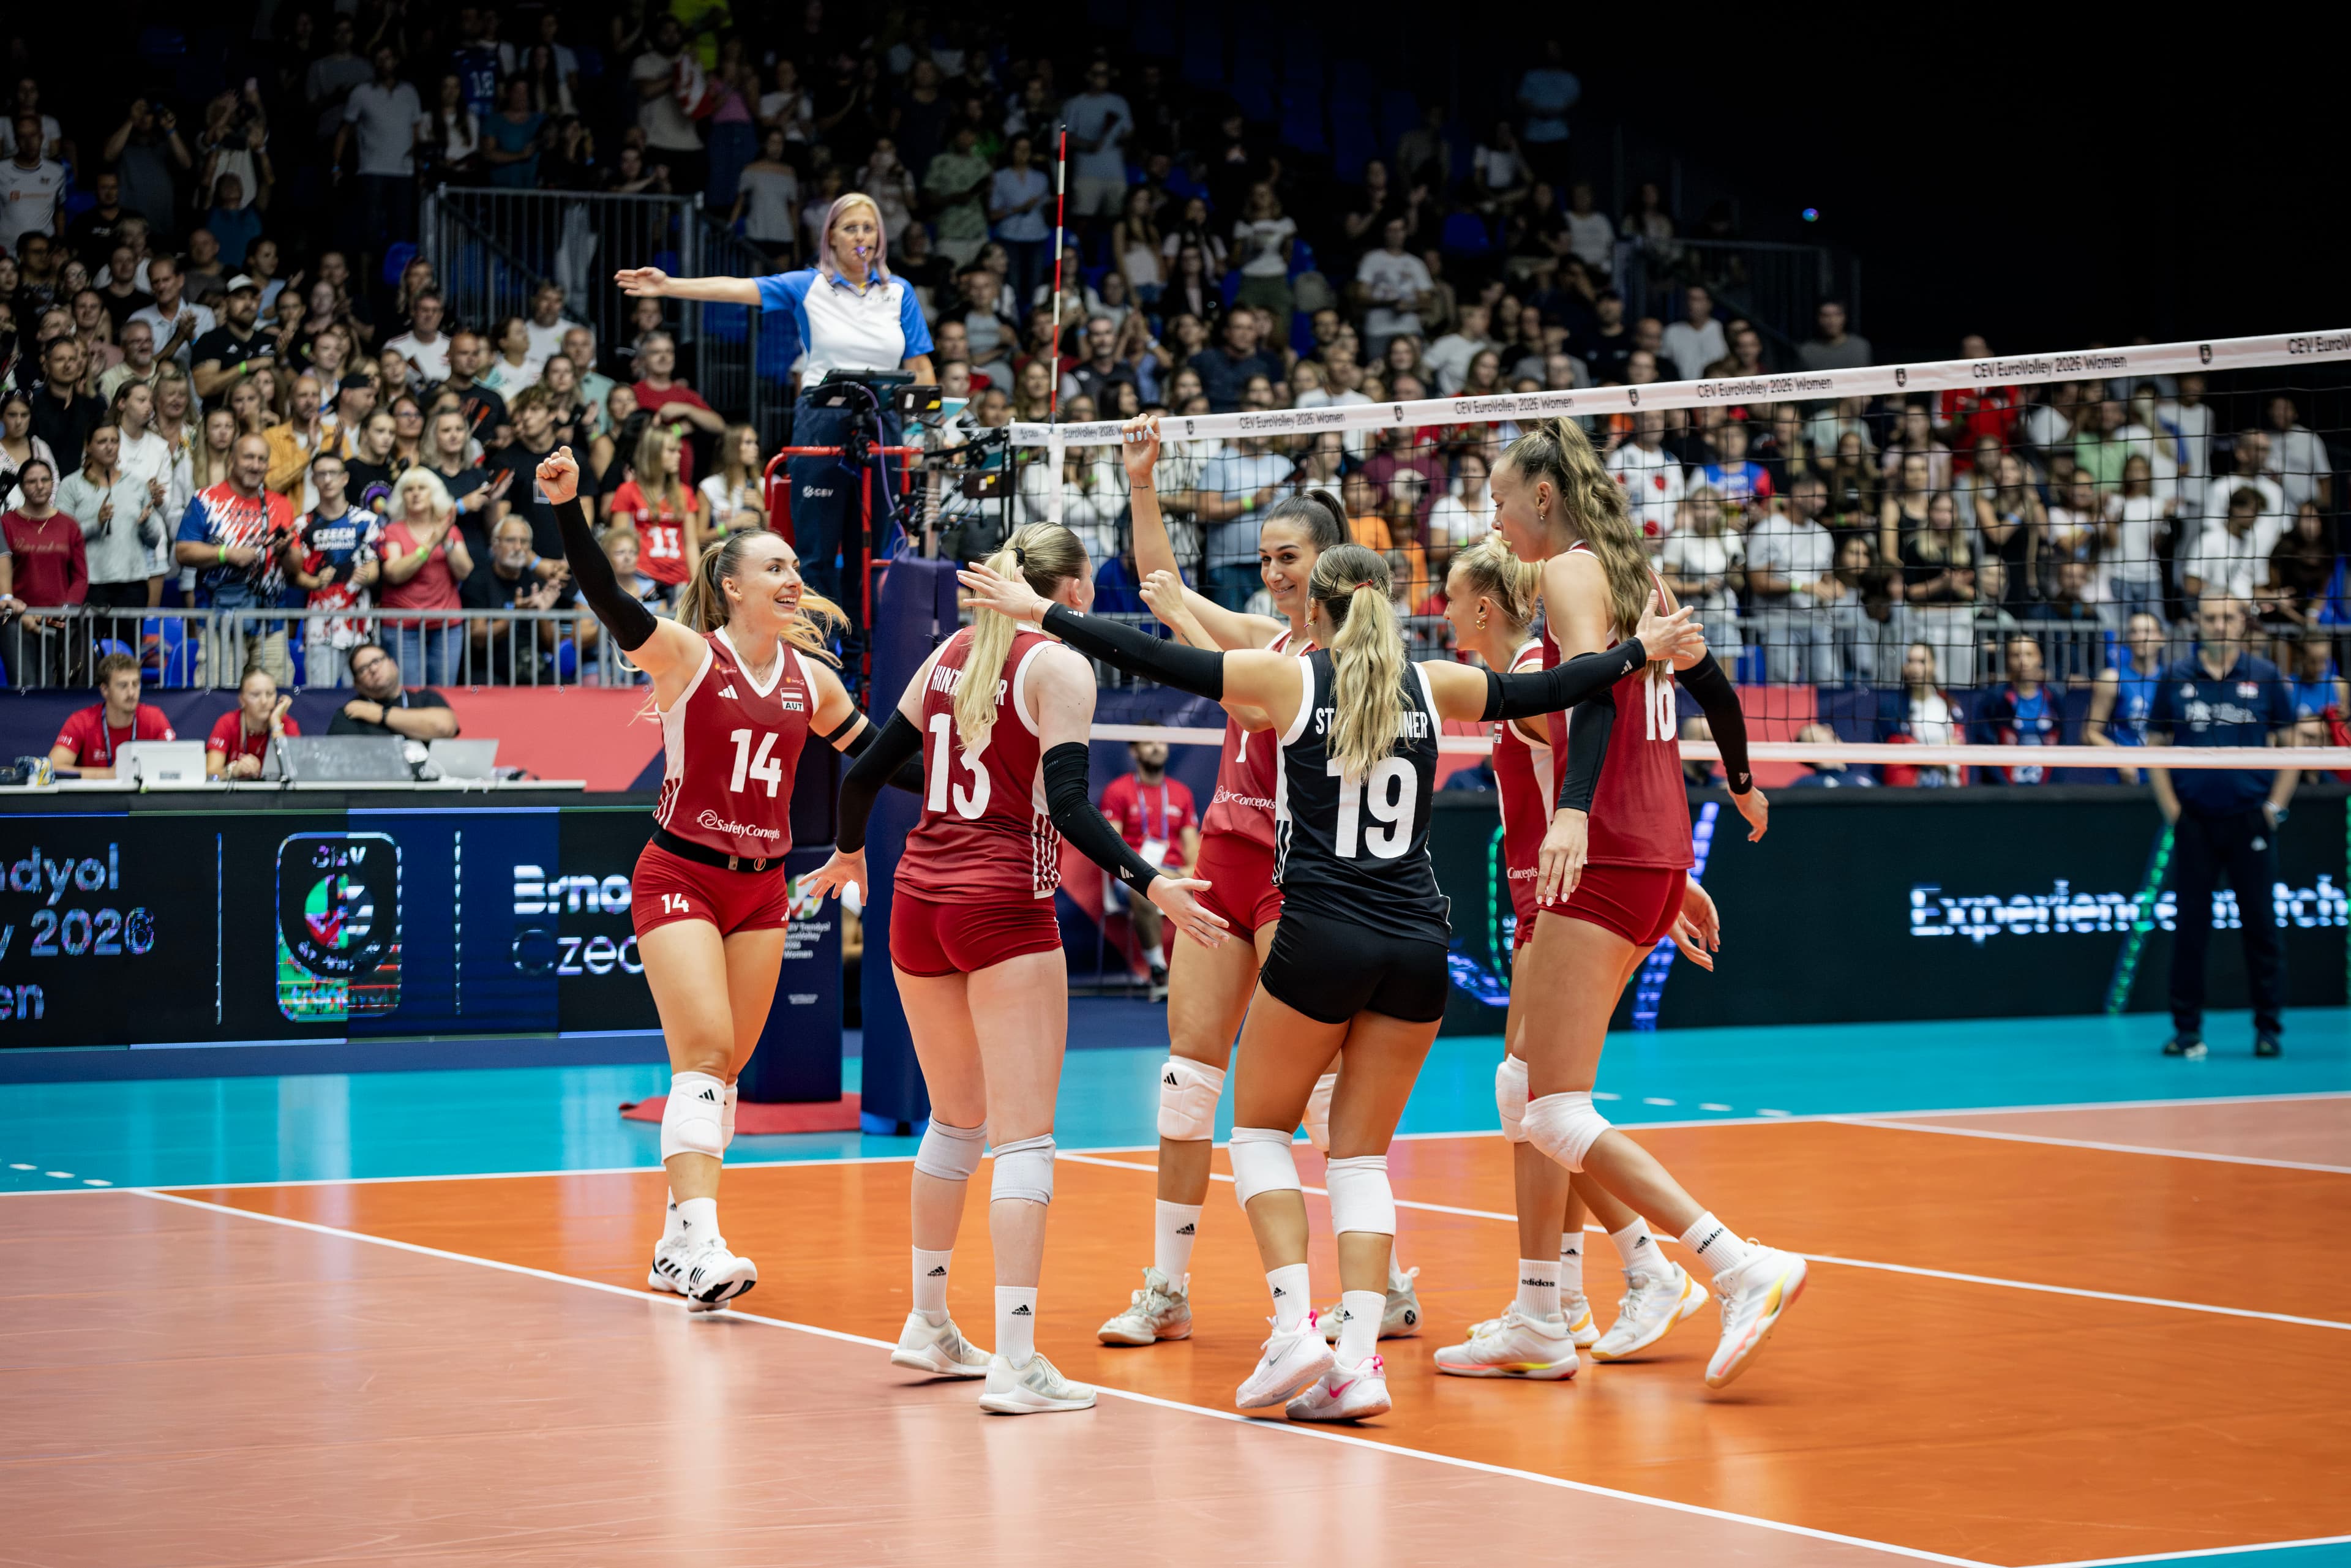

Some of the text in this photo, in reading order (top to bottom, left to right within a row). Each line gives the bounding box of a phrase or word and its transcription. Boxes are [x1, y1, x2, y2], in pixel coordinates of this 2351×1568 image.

[2288, 337, 2313, 354] CEV
[1973, 354, 2128, 378] CEV EuroVolley 2026 Women
[1698, 376, 1833, 397] CEV EuroVolley 2026 Women
[1455, 396, 1575, 415] CEV EuroVolley 2026 Women
[1098, 425, 1116, 437] 2026
[1240, 412, 1346, 429] CEV EuroVolley 2026 Women
[647, 527, 681, 559] 11
[786, 702, 803, 711] AUT
[730, 729, 782, 798] 14
[928, 713, 991, 819] 13
[1327, 756, 1418, 860] 19
[717, 819, 780, 842] SafetyConcepts
[514, 865, 632, 914] Brno
[661, 893, 689, 914] 14
[31, 907, 154, 956] 2026
[512, 928, 643, 975] Czec
[1698, 1227, 1724, 1254] adidas
